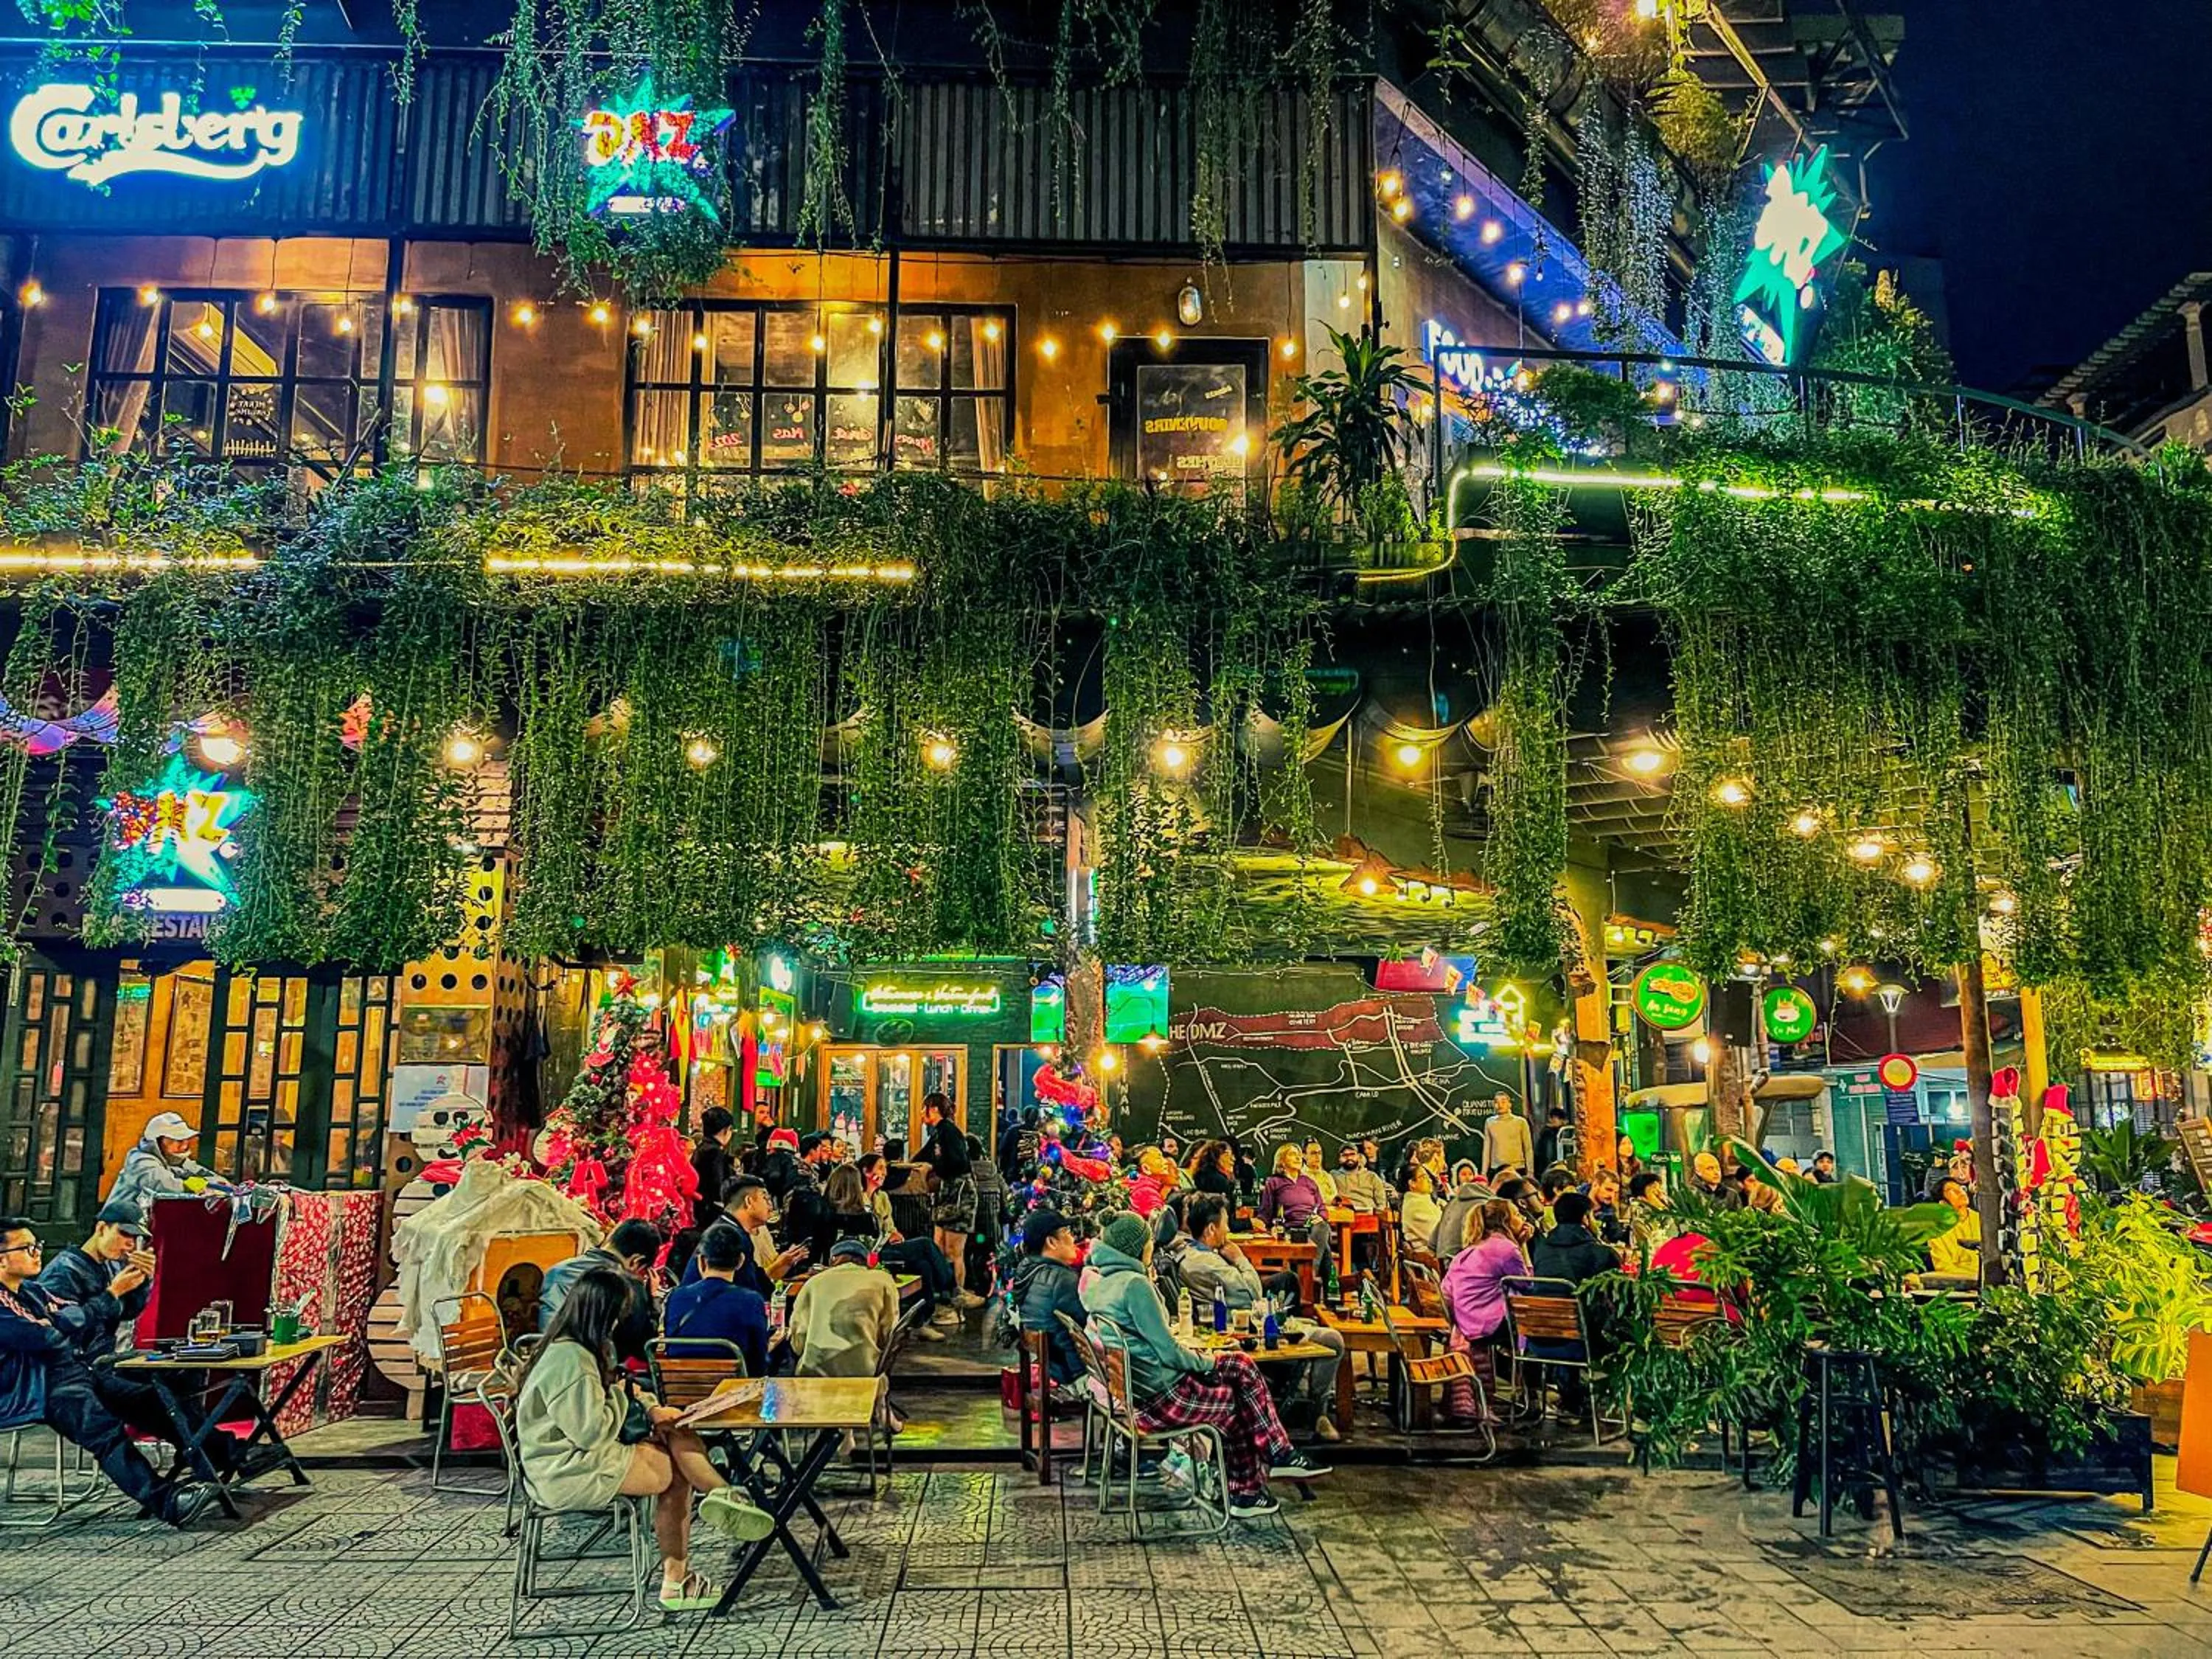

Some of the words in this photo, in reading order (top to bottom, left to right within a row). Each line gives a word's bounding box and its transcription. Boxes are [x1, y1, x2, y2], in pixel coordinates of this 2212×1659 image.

[10, 83, 304, 184] Carlsberg
[1169, 1025, 1186, 1040] HE
[1190, 1022, 1227, 1040] DMZ
